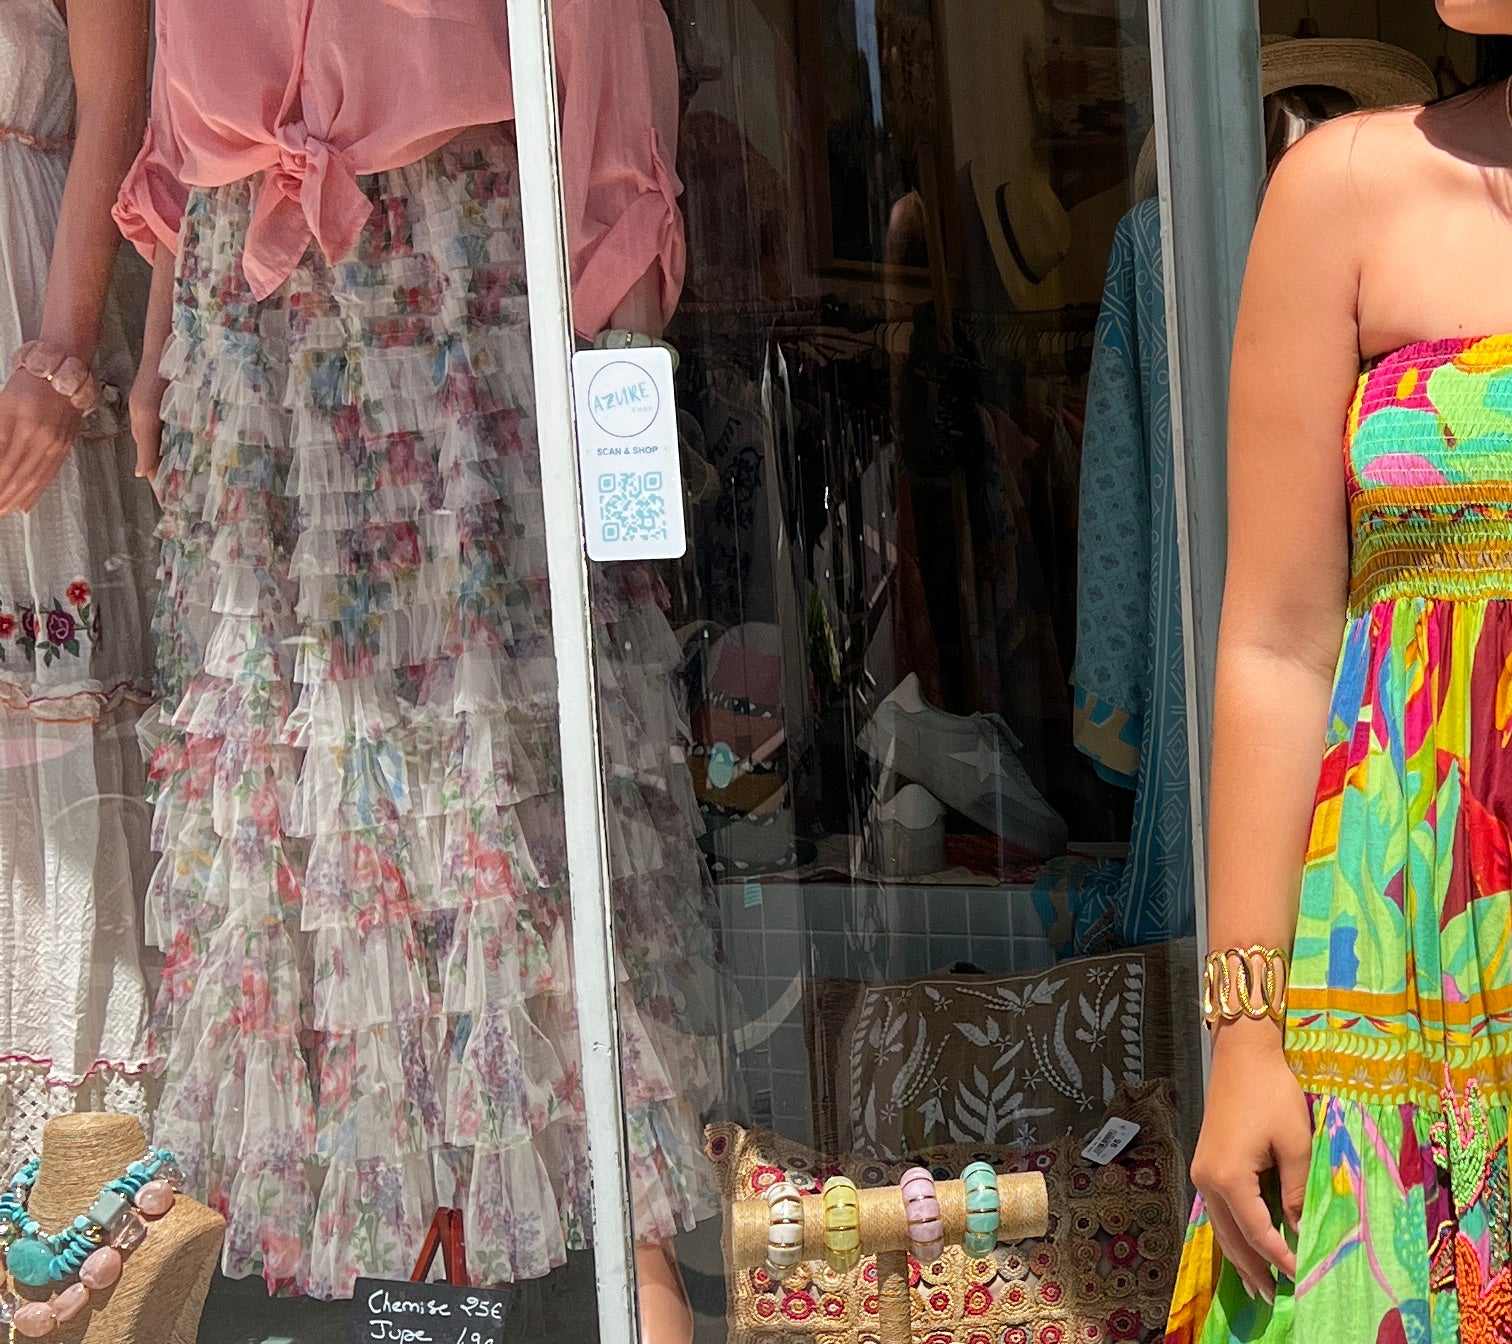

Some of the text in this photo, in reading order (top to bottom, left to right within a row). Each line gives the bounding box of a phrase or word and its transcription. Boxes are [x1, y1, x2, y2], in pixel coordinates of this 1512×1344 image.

[594, 381, 651, 413] AZURE
[597, 445, 659, 456] SCAN & SHOP
[368, 1289, 451, 1316] Chemise
